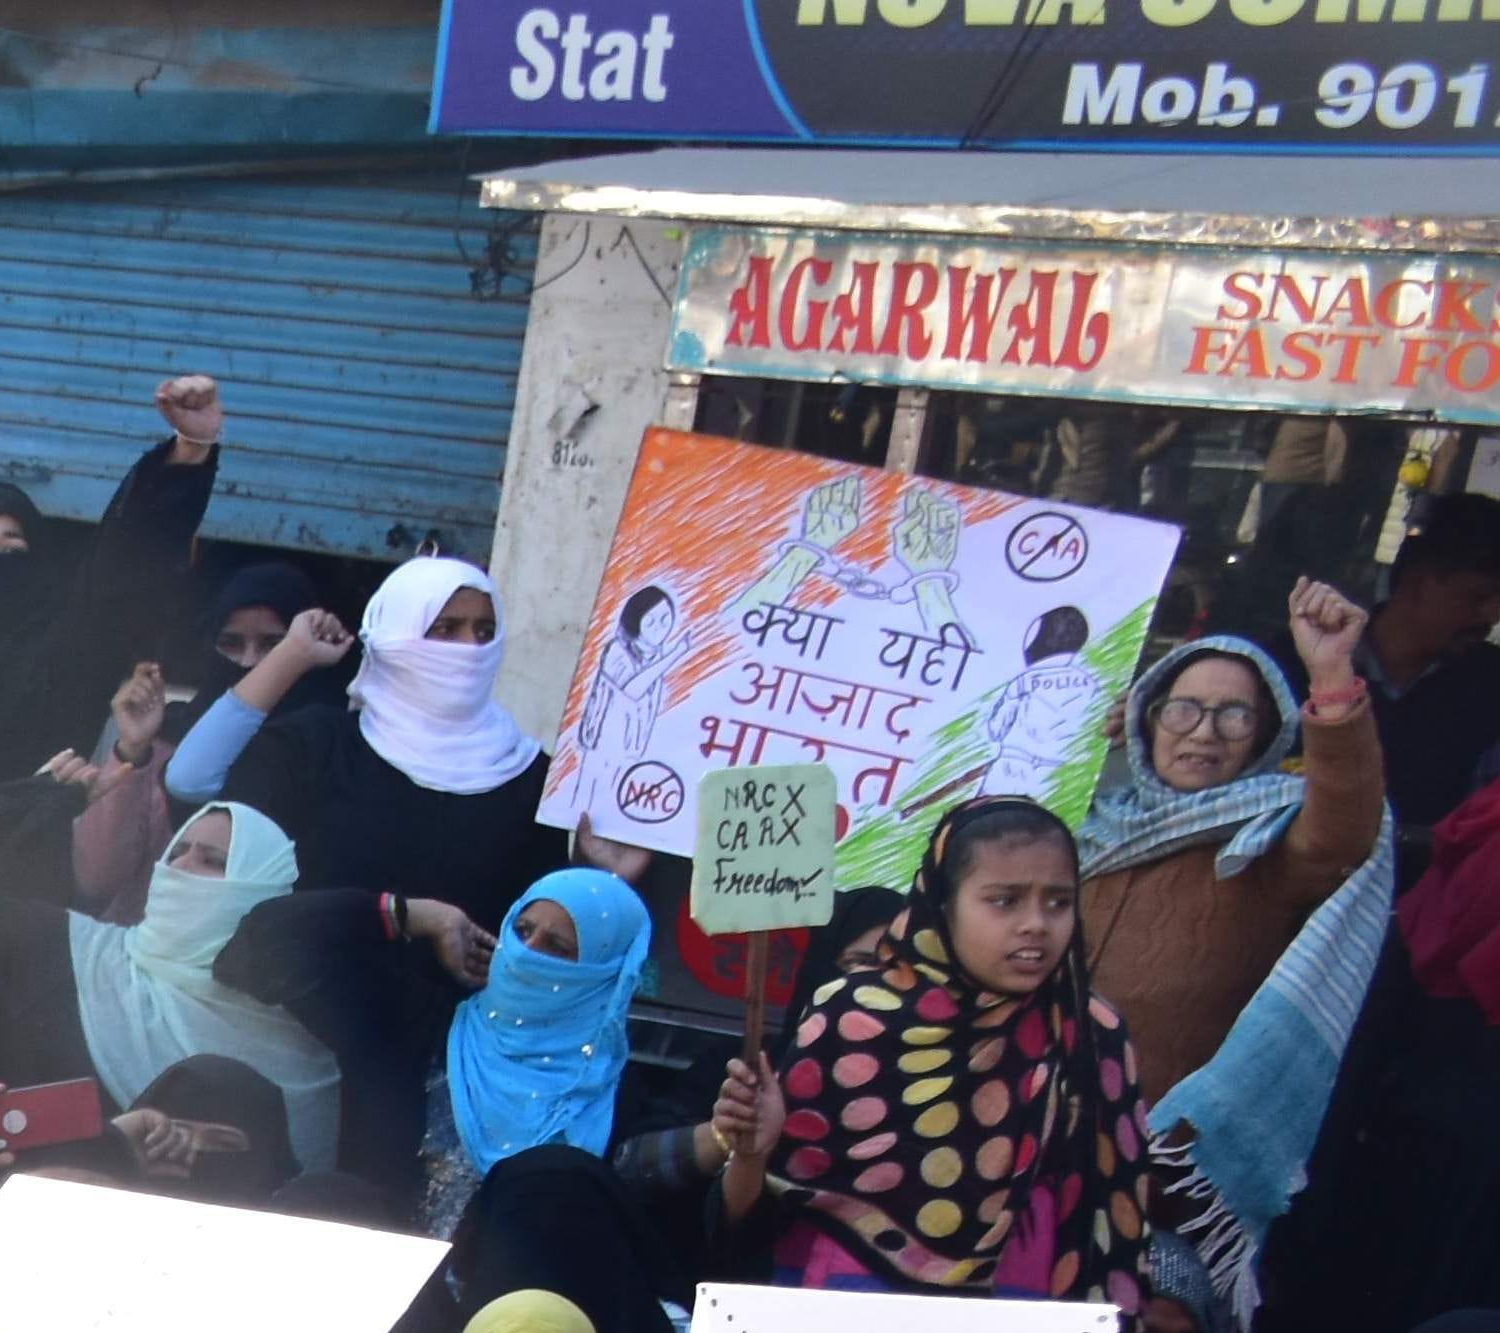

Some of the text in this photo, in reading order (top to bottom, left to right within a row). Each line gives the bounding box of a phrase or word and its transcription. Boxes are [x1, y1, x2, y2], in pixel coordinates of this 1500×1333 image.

[510, 8, 674, 105] Stat
[1062, 63, 1500, 128] Mob. 901
[725, 255, 1110, 373] AGARWAL
[1216, 271, 1500, 335] SNACK
[1182, 326, 1380, 385] FAST
[742, 601, 985, 692] क्या यही
[729, 662, 933, 744] आज़ाद
[724, 780, 776, 814] NRC
